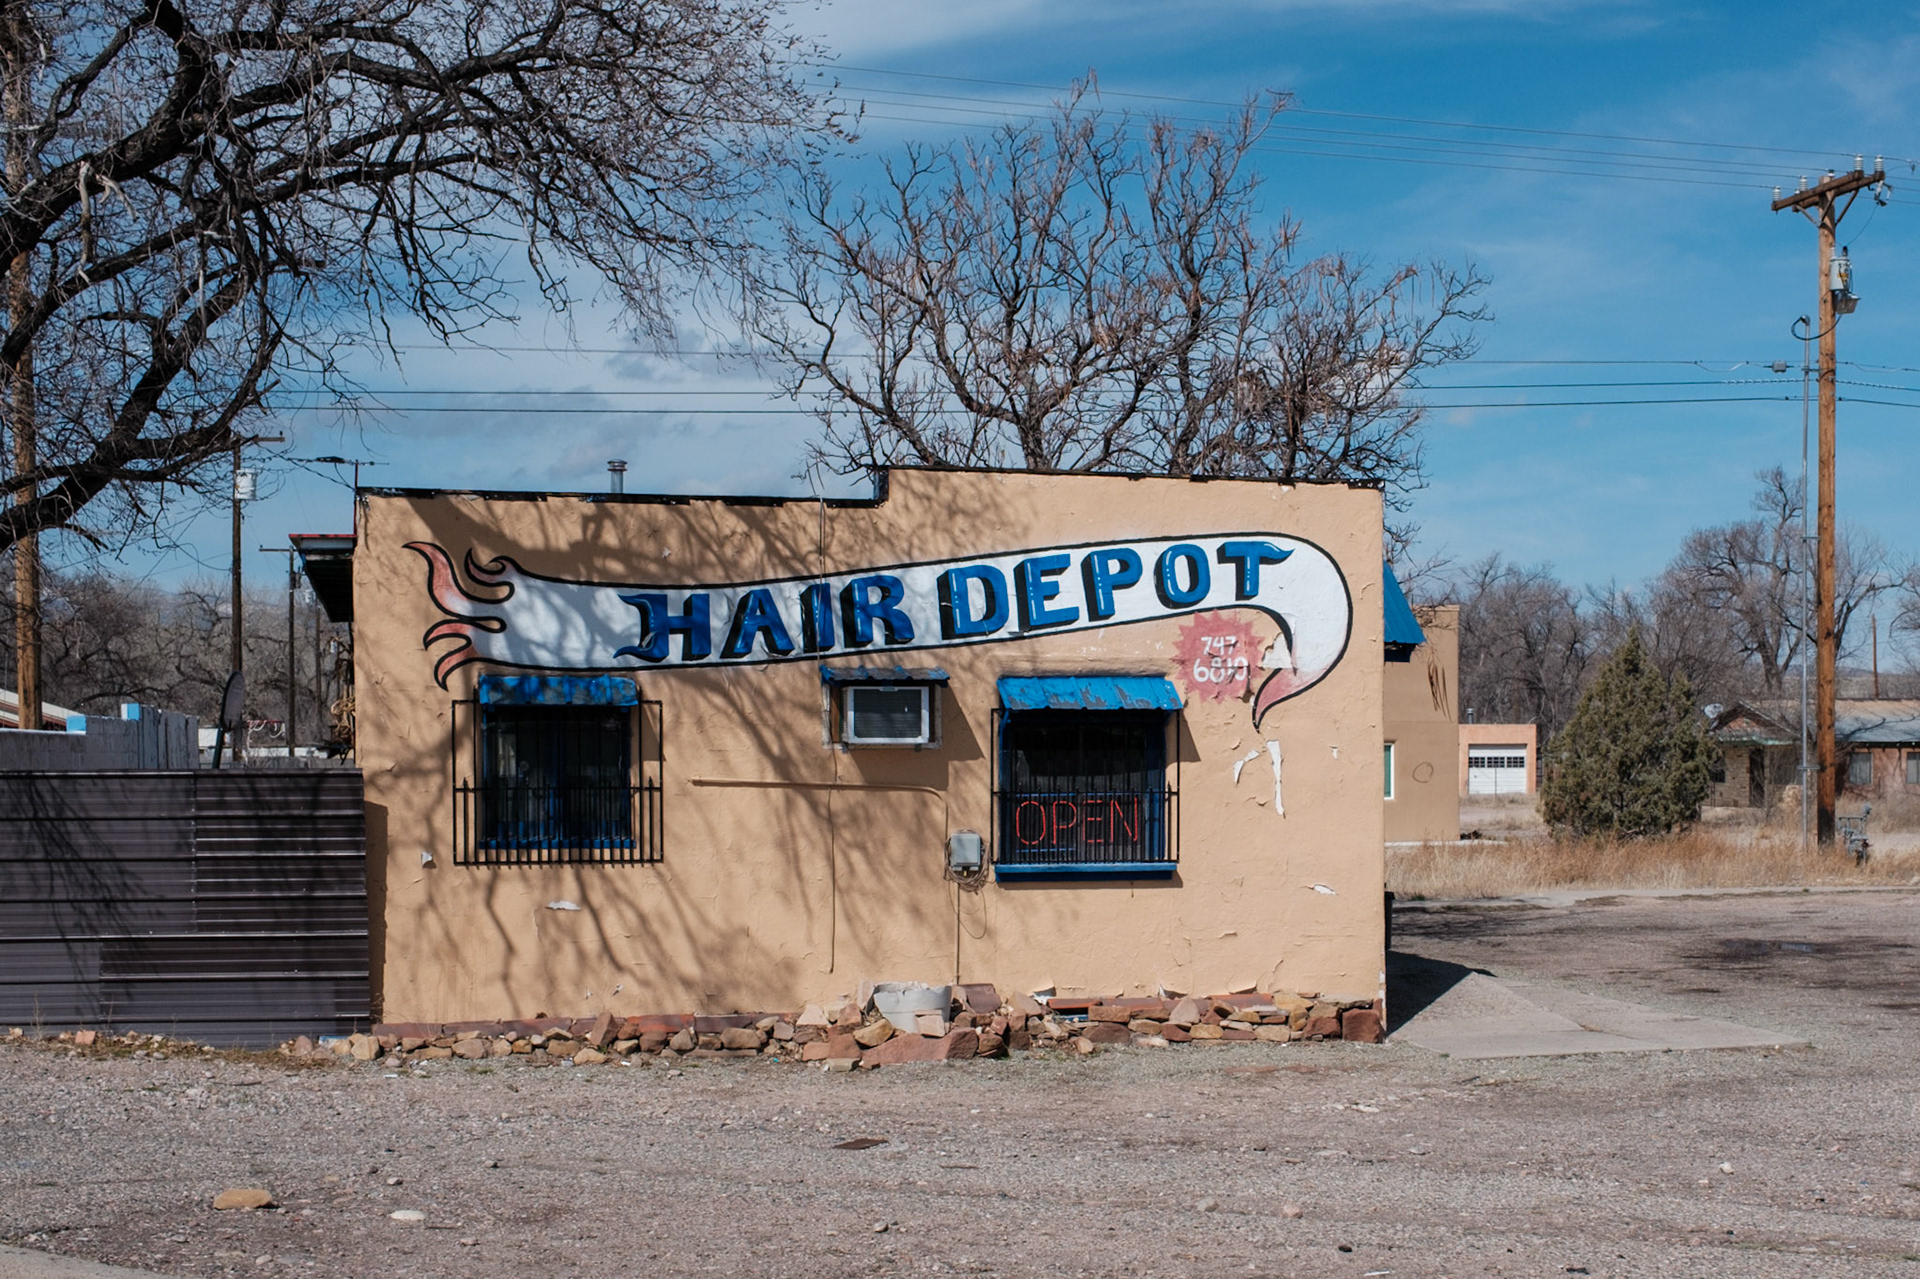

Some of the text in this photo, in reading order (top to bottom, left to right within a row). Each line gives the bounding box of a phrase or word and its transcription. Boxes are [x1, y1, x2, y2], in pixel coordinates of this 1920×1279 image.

[613, 541, 1295, 663] HAIR DEPOT
[1201, 635, 1239, 655] 747
[1016, 797, 1138, 845] OPEN
